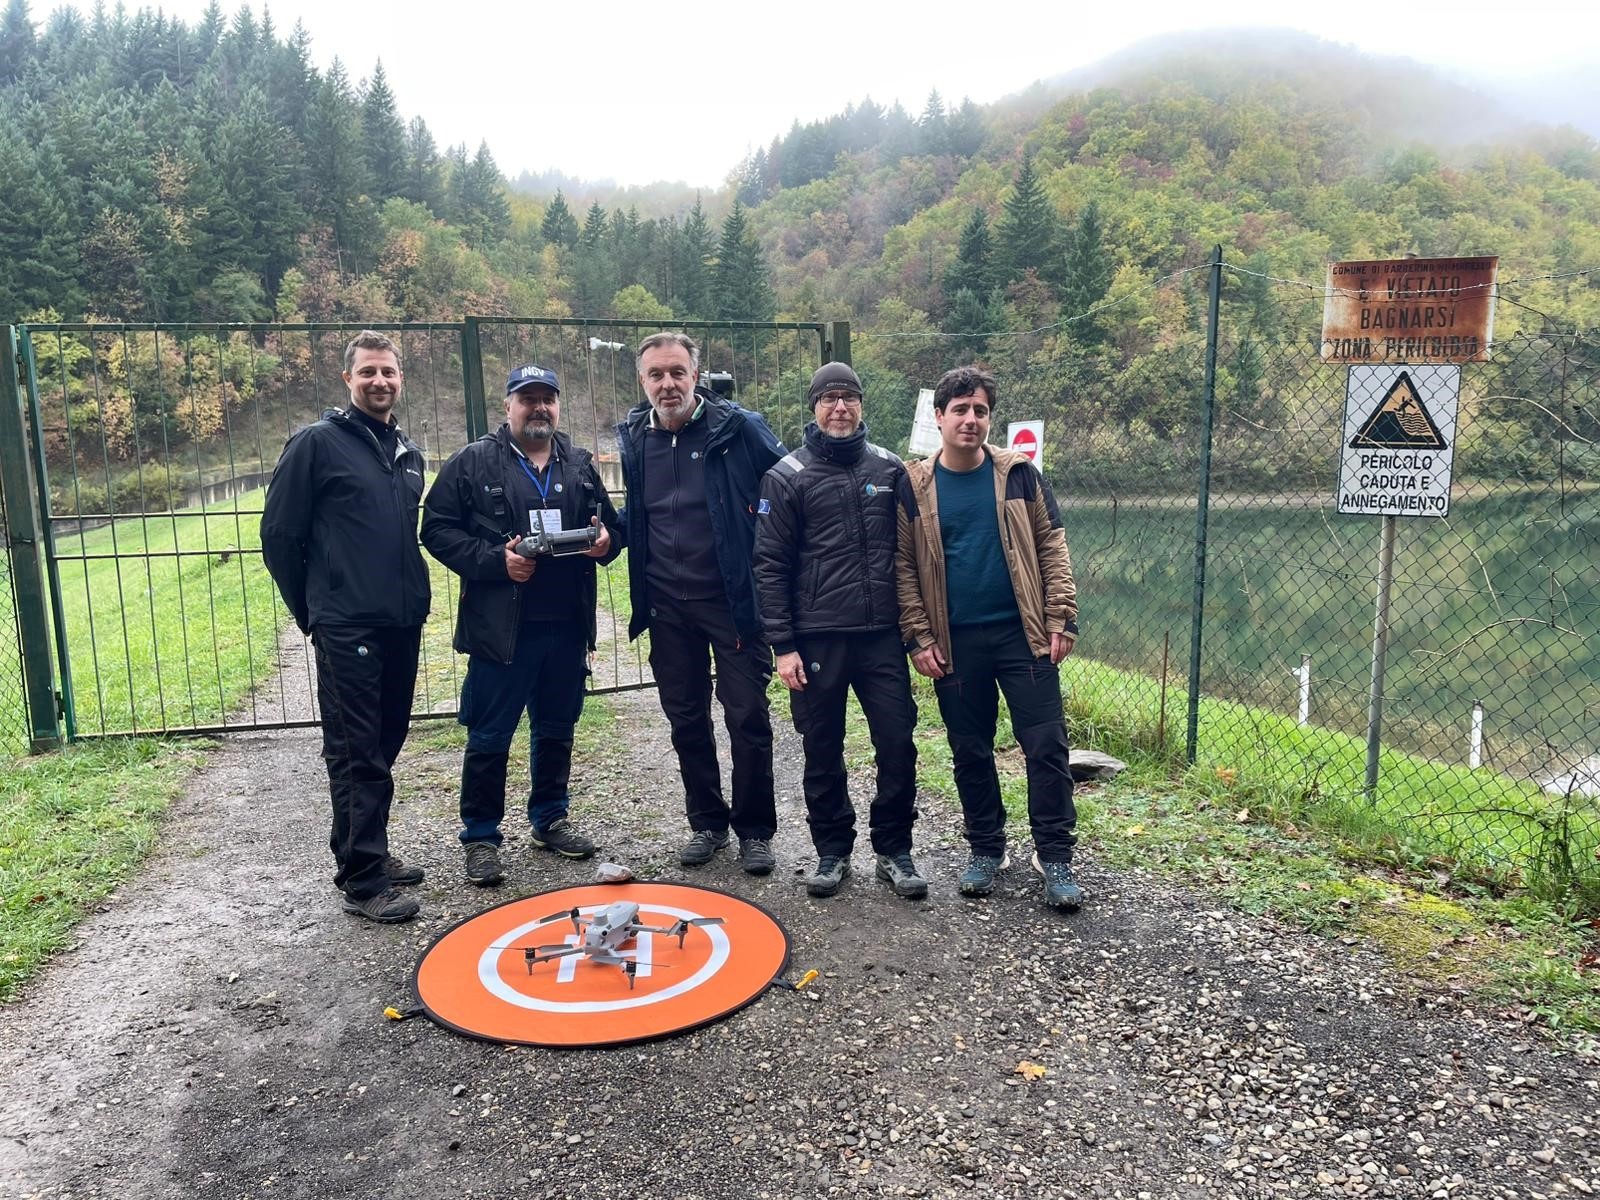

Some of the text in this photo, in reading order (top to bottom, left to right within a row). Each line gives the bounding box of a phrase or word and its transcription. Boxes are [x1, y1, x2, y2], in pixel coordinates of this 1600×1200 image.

[1332, 265, 1367, 275] COMUNE
[1387, 275, 1460, 300] VIETATO
[1360, 305, 1456, 330] BAGNARSI
[1333, 336, 1371, 359] ZONA
[521, 366, 545, 378] INGV
[1360, 454, 1433, 470] PERICOLO
[1360, 474, 1430, 490] CADUTA E
[1341, 493, 1446, 511] ANNEGAMENTO
